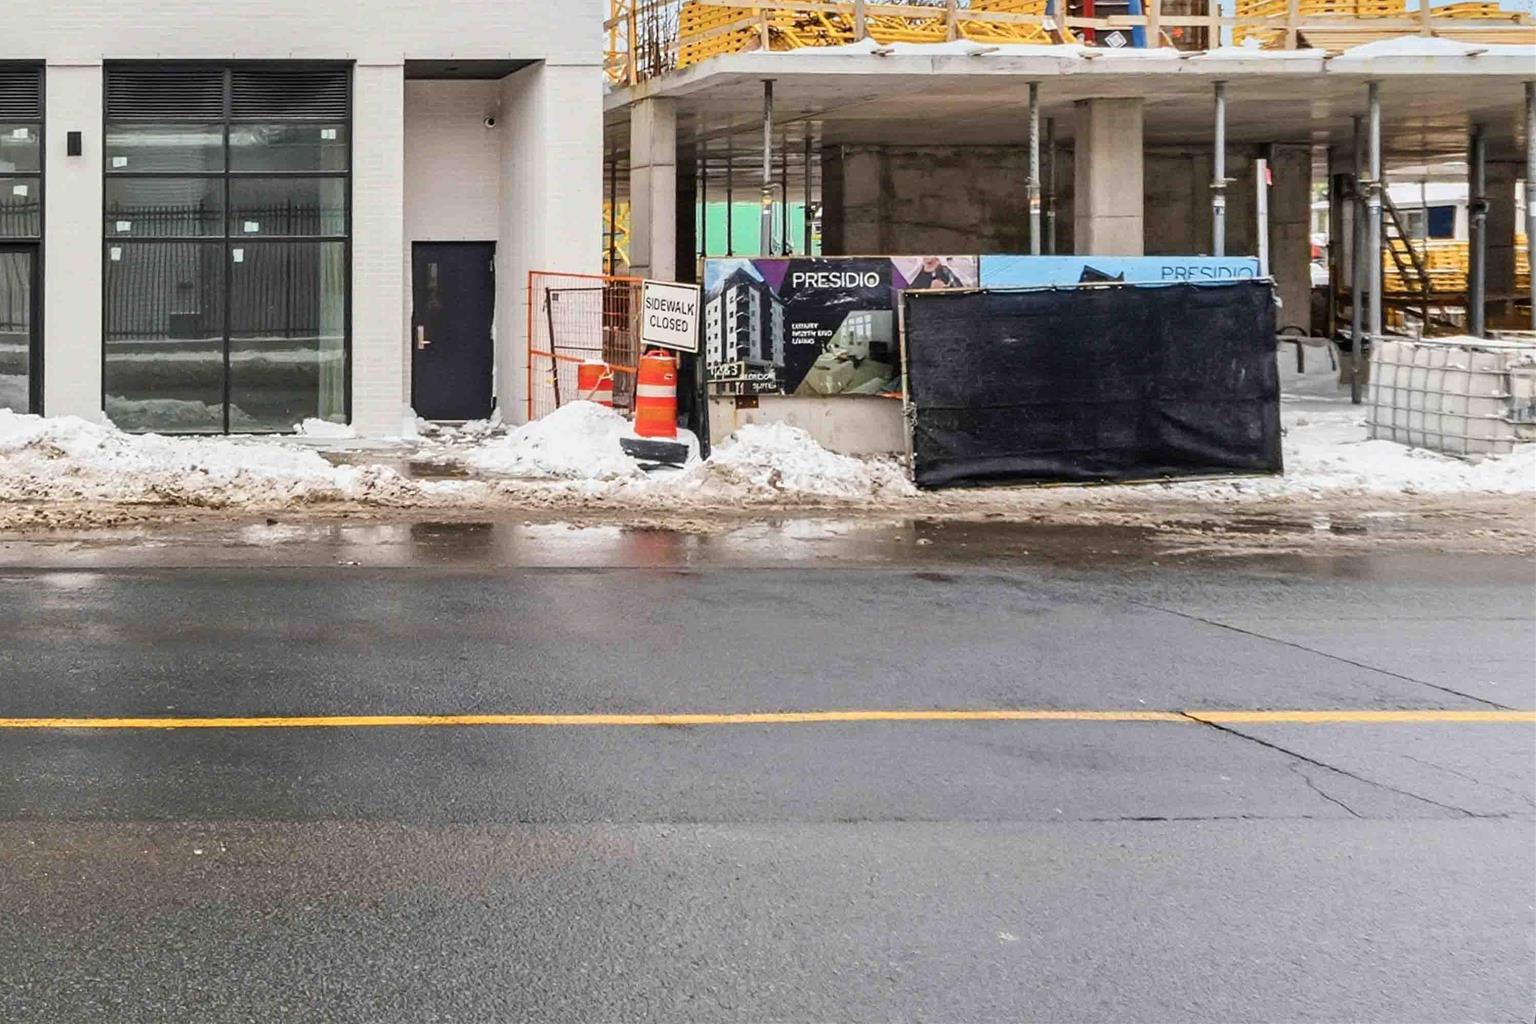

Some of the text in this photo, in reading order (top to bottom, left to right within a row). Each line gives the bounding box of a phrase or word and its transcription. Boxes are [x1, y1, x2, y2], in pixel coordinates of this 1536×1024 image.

[792, 272, 880, 288] PRESIDIO
[645, 296, 695, 316] SIDEWALK
[649, 314, 689, 333] CLOSED
